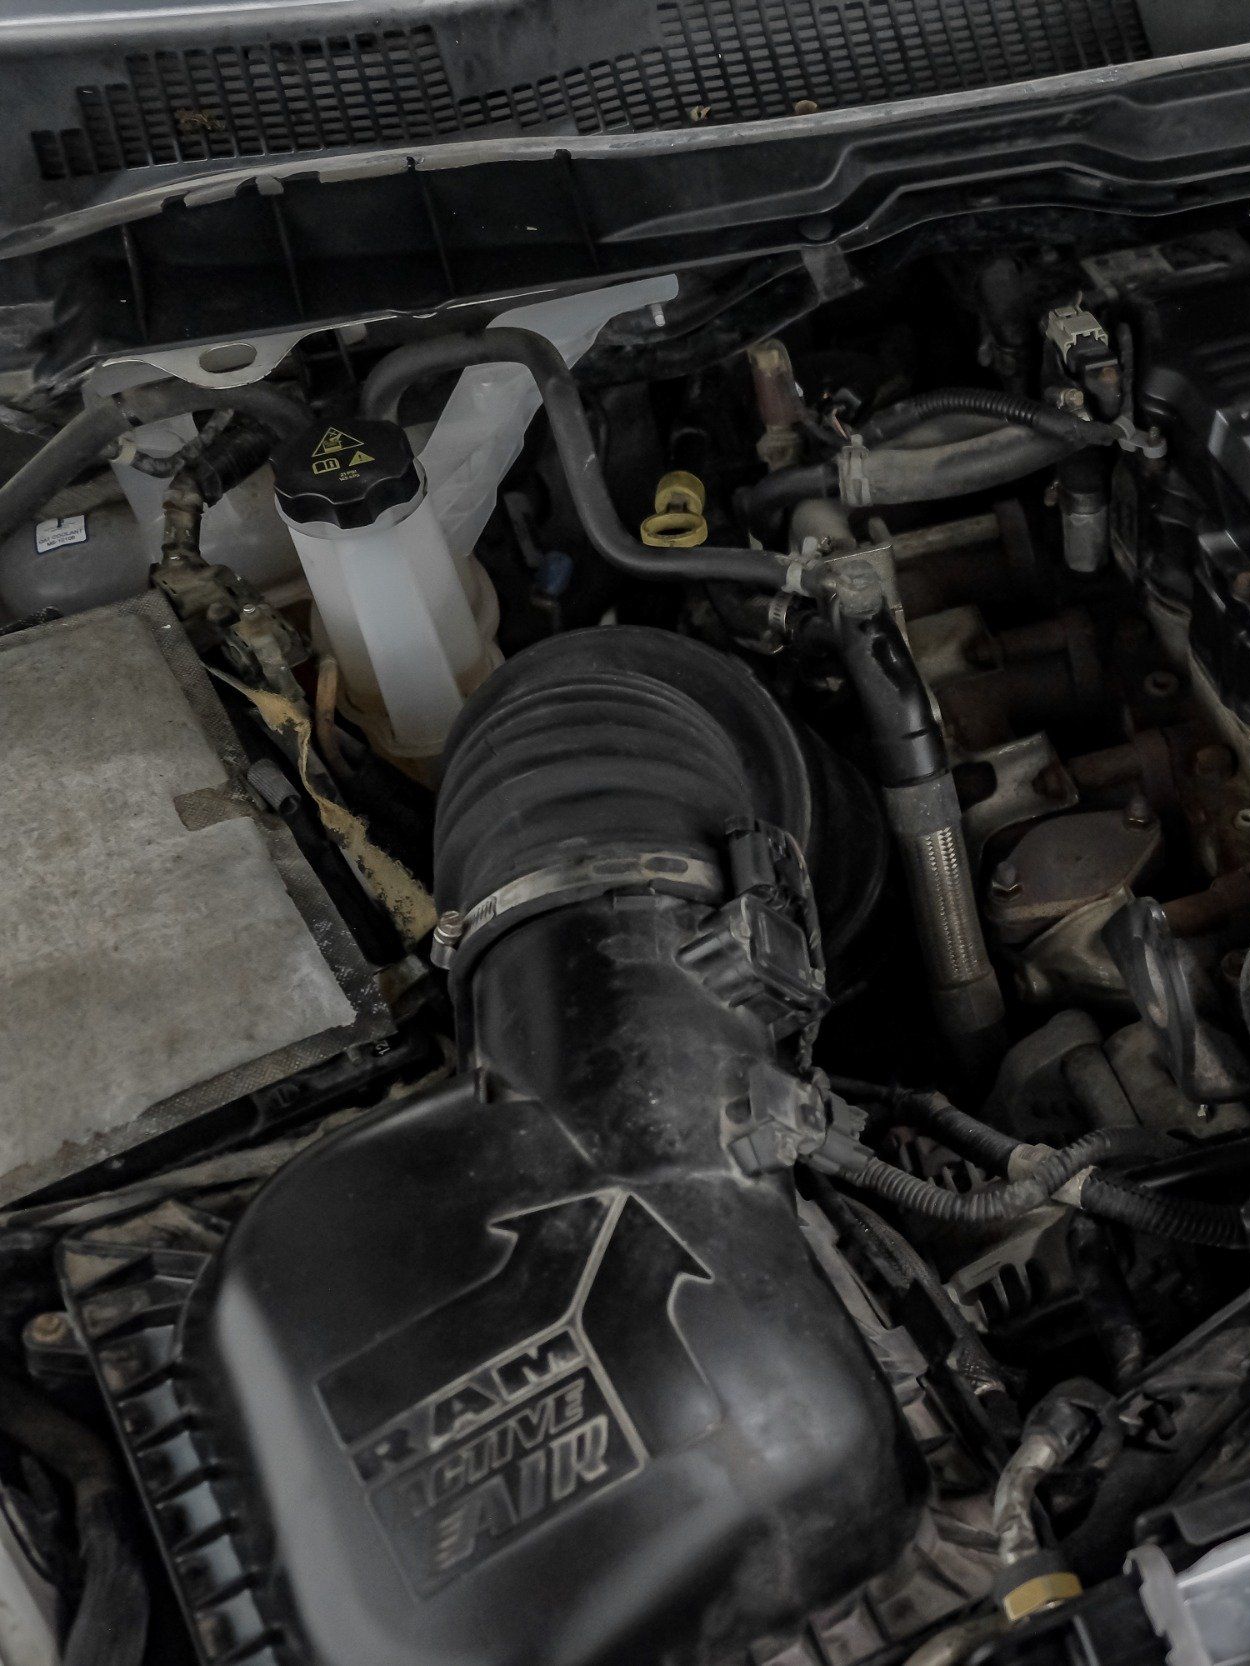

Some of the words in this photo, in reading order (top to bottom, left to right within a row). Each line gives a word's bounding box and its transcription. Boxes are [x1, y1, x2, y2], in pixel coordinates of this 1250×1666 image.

[354, 1331, 584, 1481] RAM
[391, 1378, 586, 1518] ACTIVE
[431, 1415, 609, 1570] AIR
